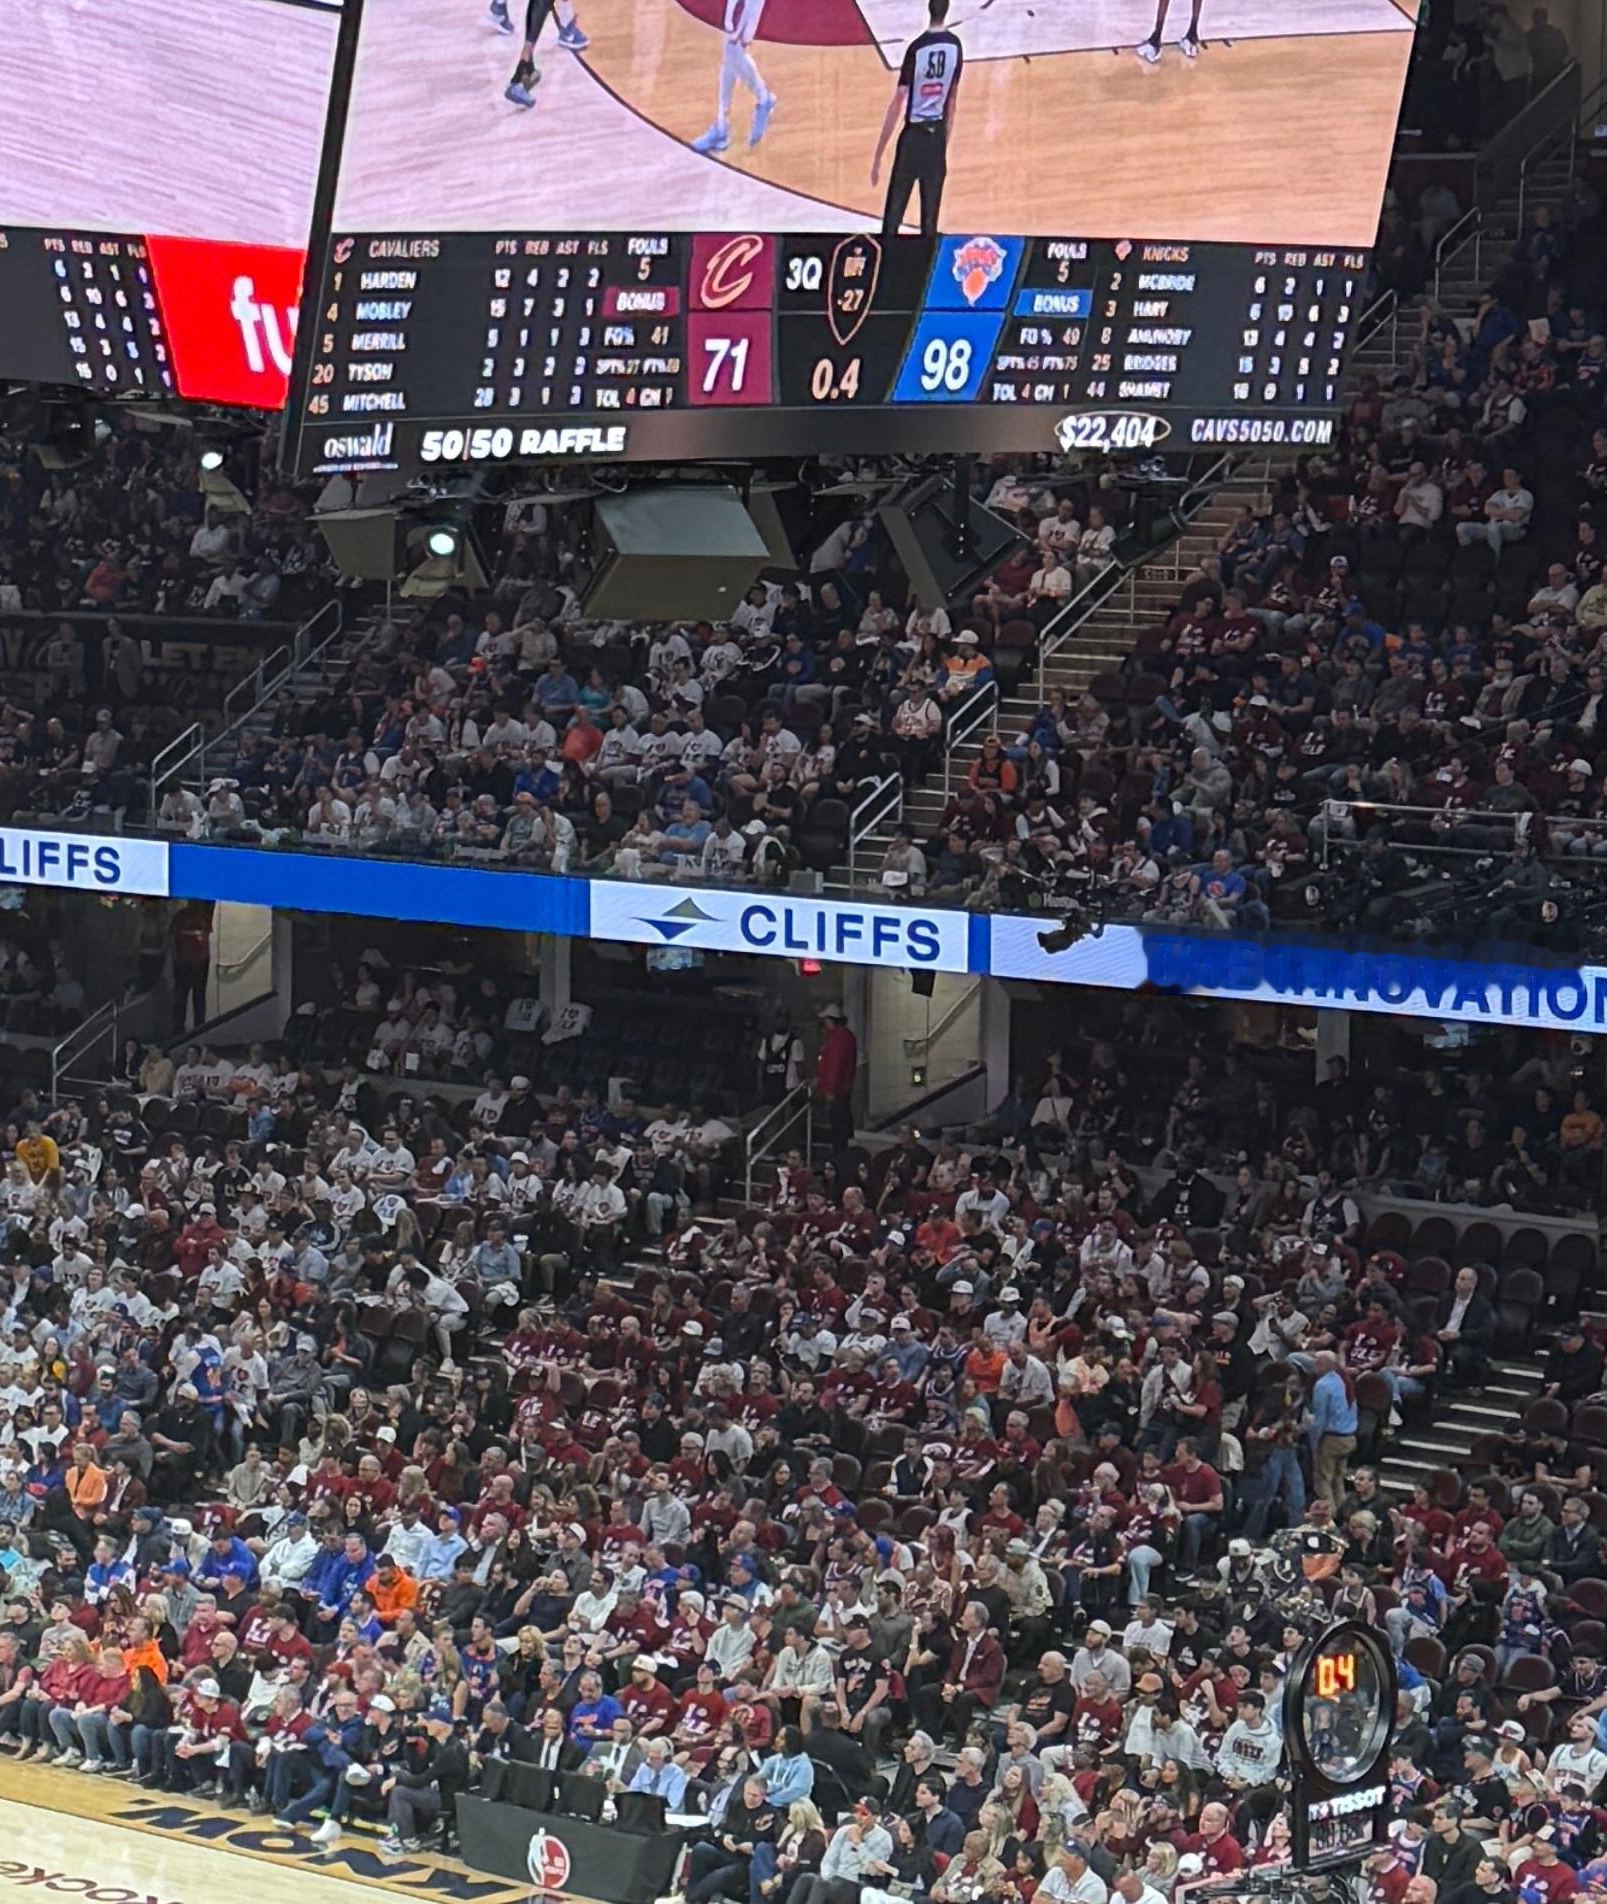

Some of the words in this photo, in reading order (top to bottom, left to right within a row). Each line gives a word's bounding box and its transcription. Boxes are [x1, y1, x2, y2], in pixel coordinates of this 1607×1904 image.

[368, 240, 440, 258] CAVALIERS
[628, 238, 668, 254] FOULS
[1048, 243, 1087, 259] FOULS
[1143, 247, 1190, 262] KNICKS
[360, 271, 417, 290] HARDEN
[638, 260, 650, 280] 5
[786, 257, 822, 290] 3Q
[1058, 261, 1069, 282] 5
[1110, 273, 1121, 291] 2
[327, 302, 338, 322] 4
[356, 301, 412, 320] MOBLEY
[1033, 295, 1079, 313] BONUS
[1106, 301, 1116, 317] 3
[323, 334, 334, 353] 5
[312, 364, 334, 384] 20
[703, 338, 748, 392] 71
[921, 338, 972, 390] 98
[812, 358, 861, 400] 0.4
[308, 395, 329, 414] 45
[343, 393, 406, 412] MITCHELL
[324, 422, 393, 458] oswald
[519, 427, 627, 455] RAFFLE
[1059, 415, 1156, 453] $22,404
[1191, 418, 1333, 444] CAVS5050.COM
[738, 903, 941, 962] CLIFFS
[1318, 1654, 1355, 1696] 0.4
[1330, 1785, 1387, 1816] TISSOT
